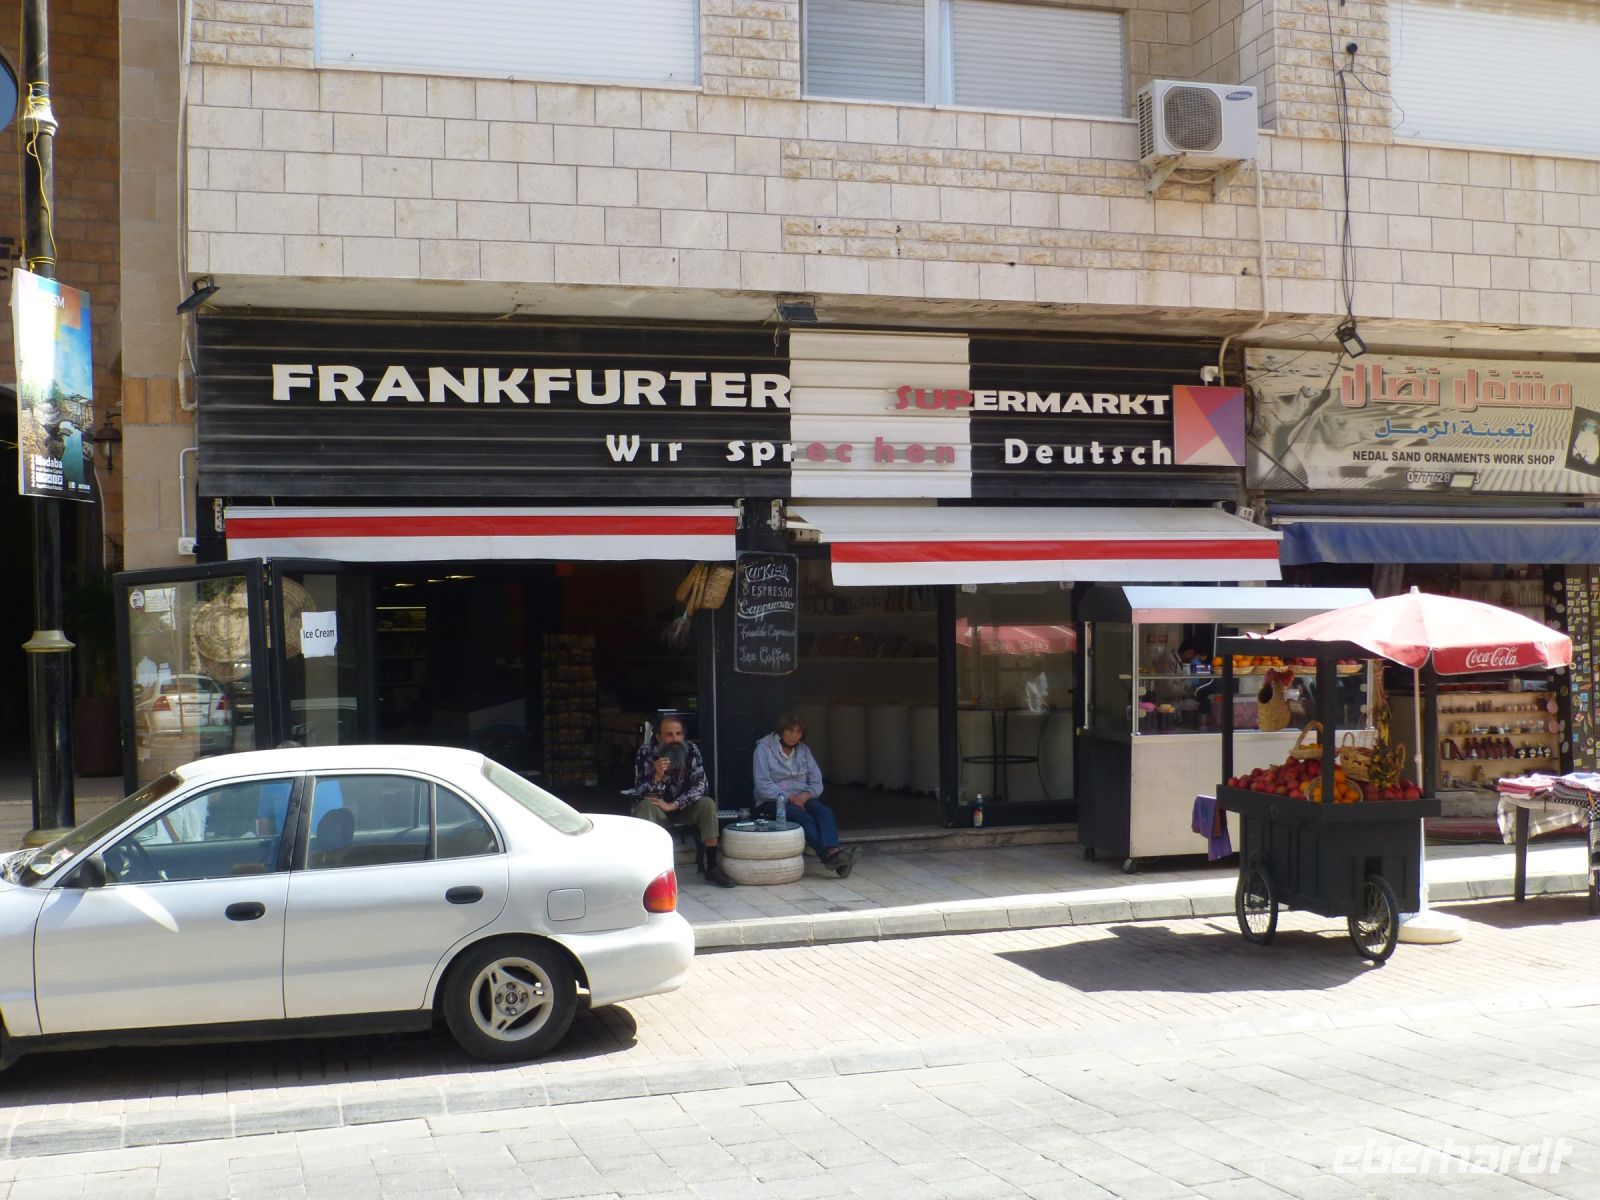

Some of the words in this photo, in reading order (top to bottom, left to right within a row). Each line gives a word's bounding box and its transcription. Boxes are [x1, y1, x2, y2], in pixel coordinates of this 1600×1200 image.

[272, 363, 791, 408] FRANKFURTER
[894, 384, 1171, 416] SUPERMARKT
[1340, 363, 1441, 408] نضال
[1453, 368, 1572, 412] مشغل
[1374, 417, 1457, 440] الرمل
[1461, 420, 1535, 444] لتعبئة
[605, 434, 683, 464] Wir
[1004, 438, 1174, 466] Deutsch
[1352, 450, 1389, 462] NEDAL
[1391, 451, 1421, 463] SAND
[1425, 452, 1491, 464] ORNAMENTS
[1493, 453, 1525, 465] WORK
[1527, 454, 1555, 466] SHOP
[1406, 471, 1480, 485] 0777283
[751, 585, 793, 598] ESPRESSO
[303, 629, 314, 639] Ice
[314, 628, 335, 638] Cream
[1465, 646, 1519, 669] Coca-Cola
